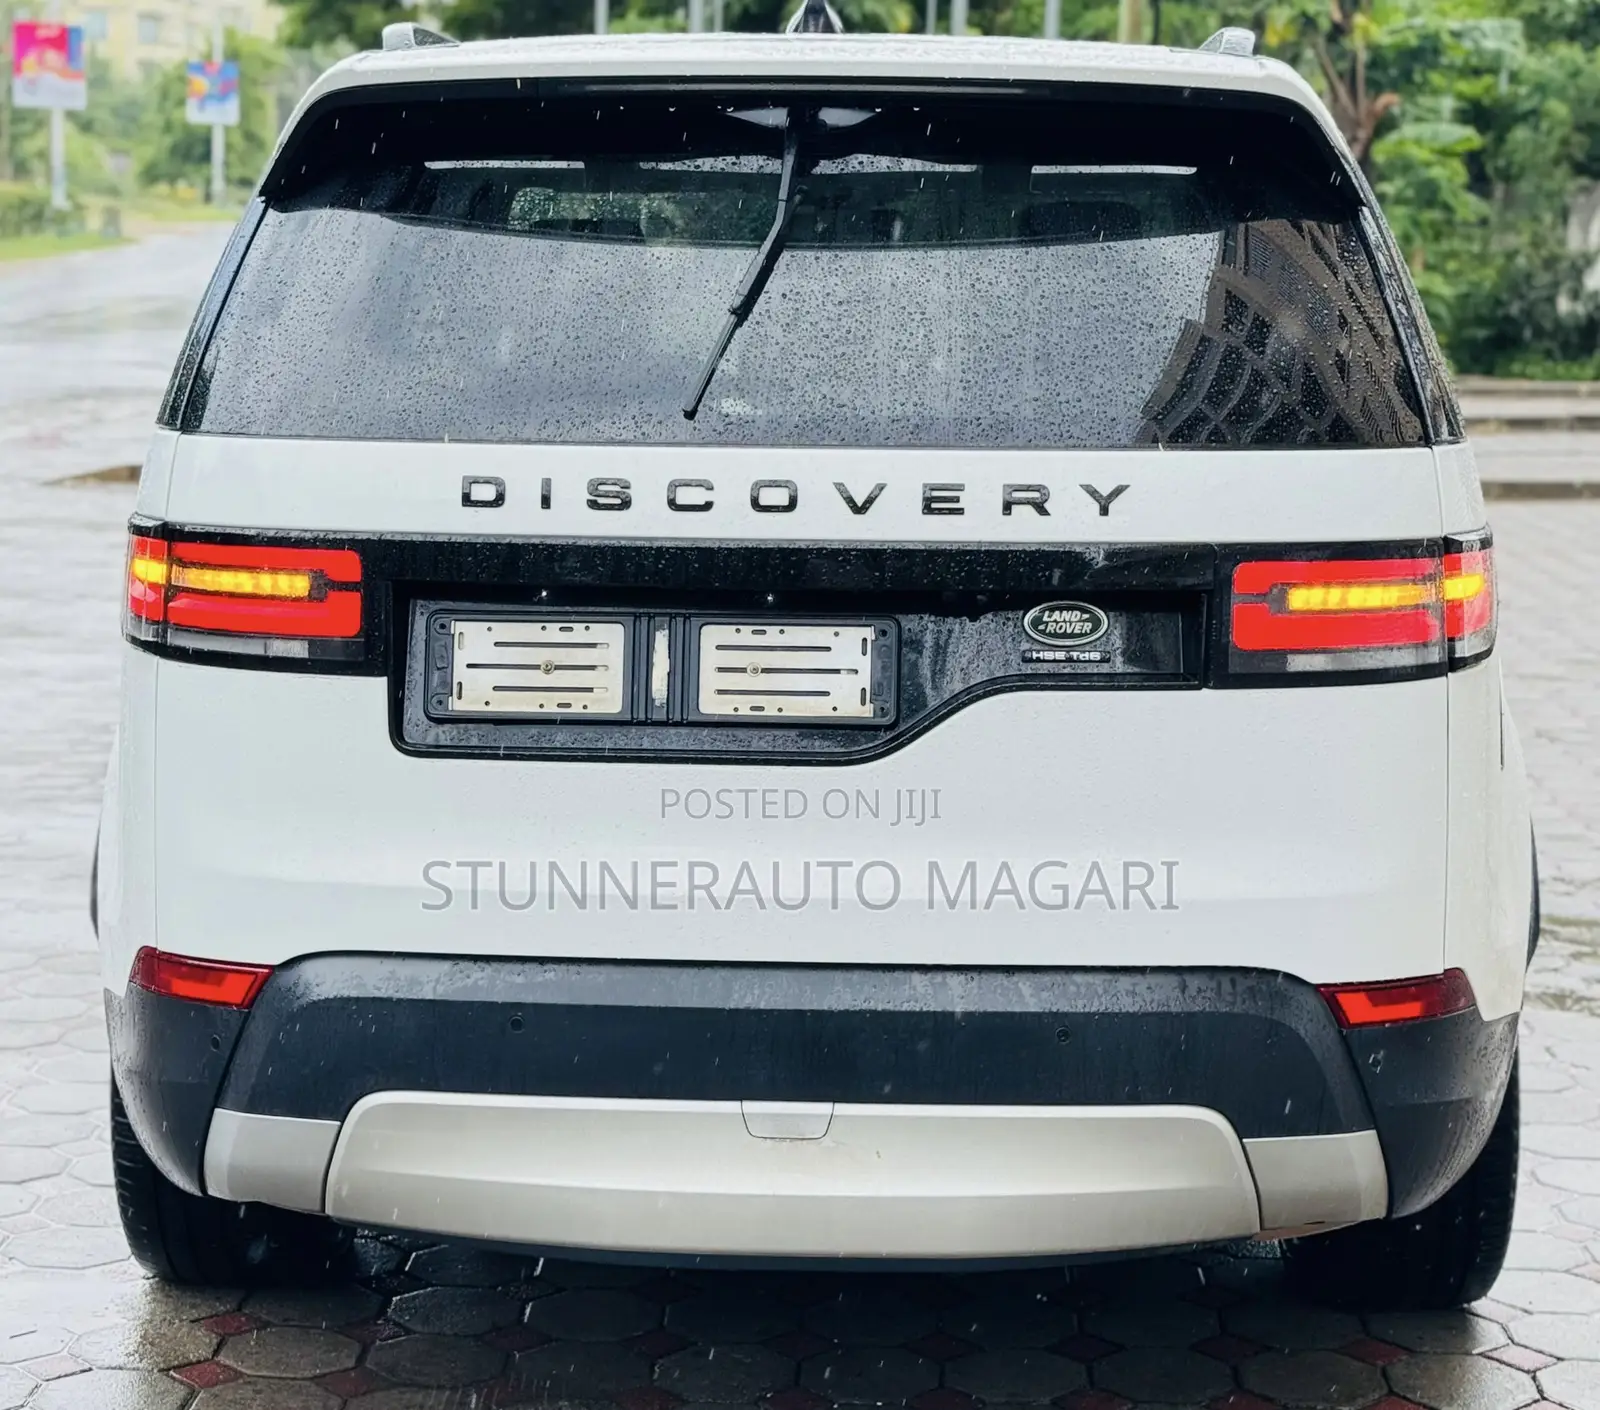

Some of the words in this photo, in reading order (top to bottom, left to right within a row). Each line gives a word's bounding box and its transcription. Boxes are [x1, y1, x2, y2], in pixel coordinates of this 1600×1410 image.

[461, 475, 1131, 516] DISCOVERY
[1042, 611, 1081, 621] LAND
[1045, 622, 1092, 633] ROVER
